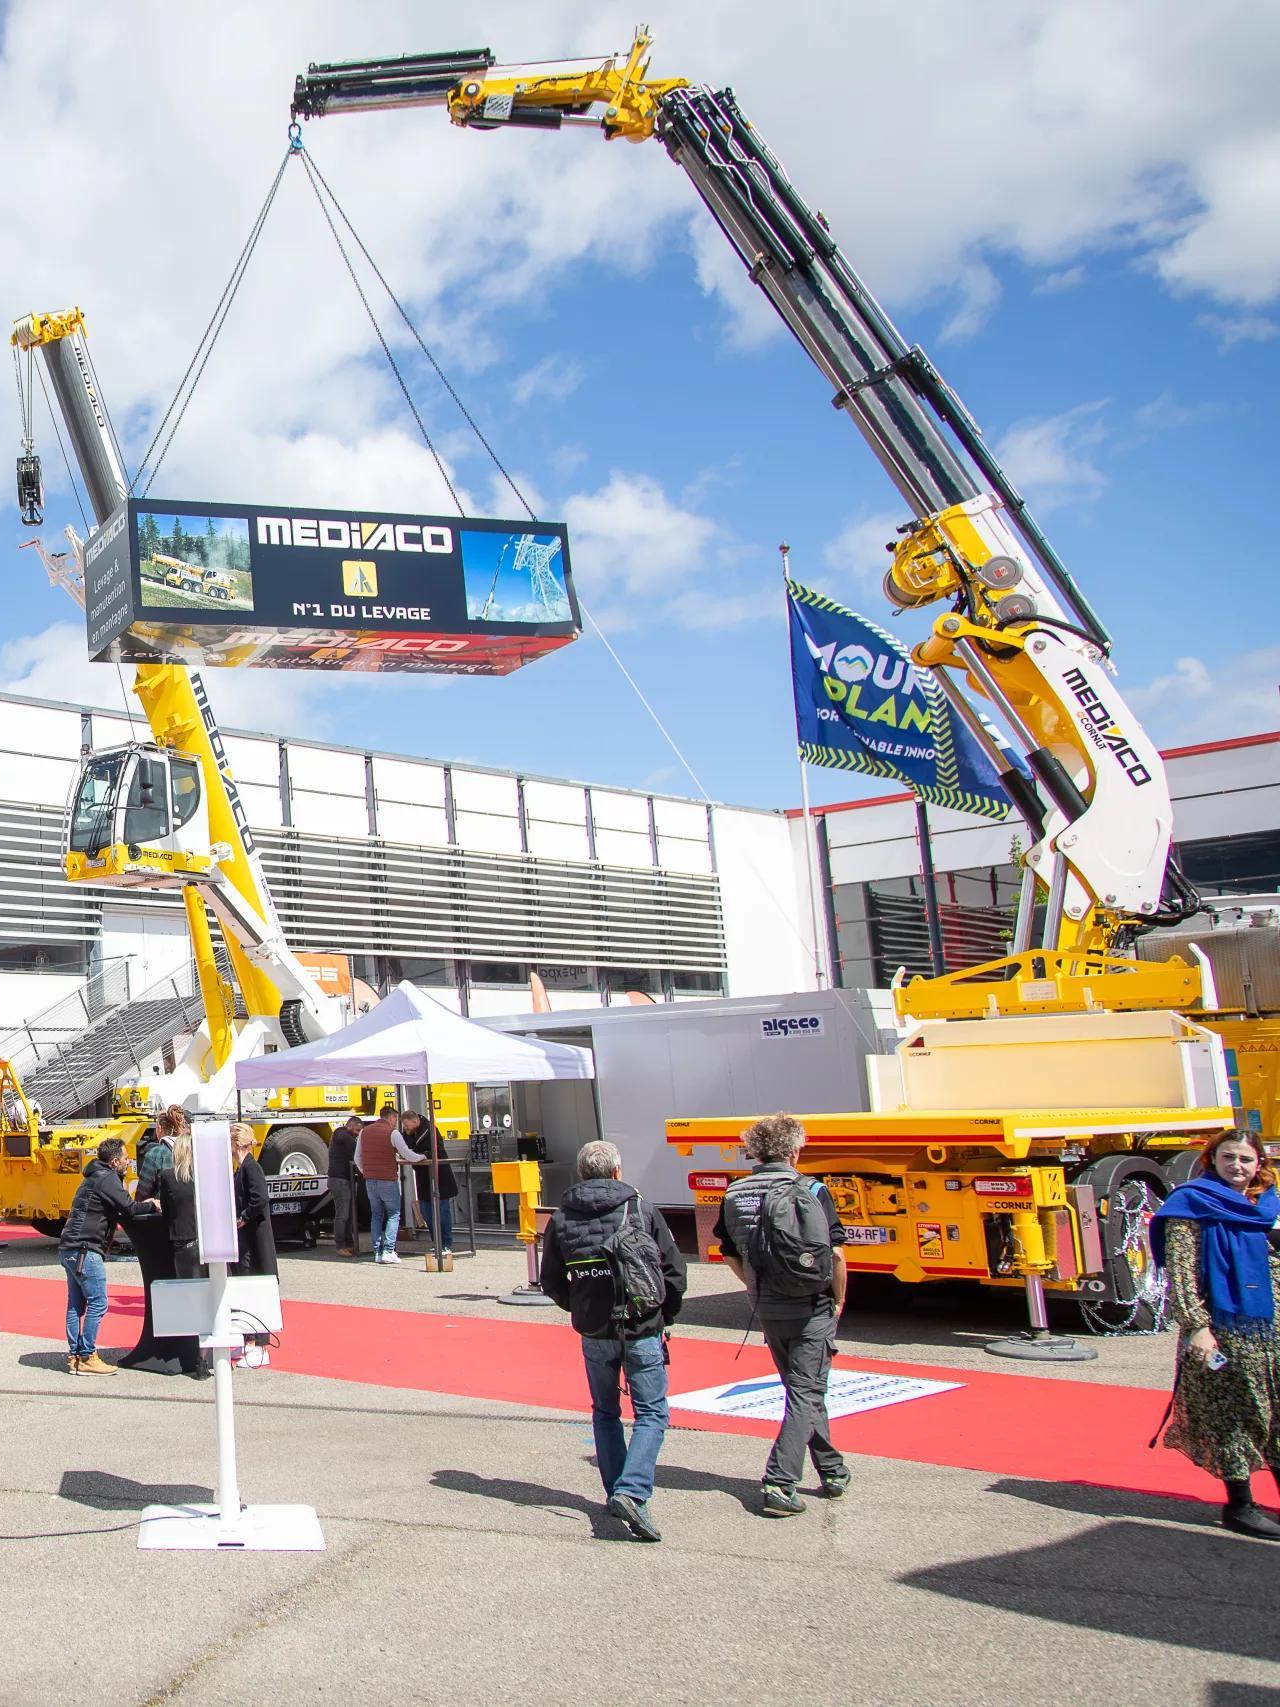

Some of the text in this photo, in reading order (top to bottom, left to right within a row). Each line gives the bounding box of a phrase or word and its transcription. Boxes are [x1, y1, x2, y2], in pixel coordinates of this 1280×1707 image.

[94, 559, 120, 594] Levage &
[90, 580, 126, 621] manutention
[330, 604, 356, 617] DU
[362, 605, 431, 621] LEVAGE
[92, 604, 128, 643] en montagne
[402, 661, 505, 673] montagne
[1080, 717, 1107, 750] CORNUT
[762, 1017, 820, 1036] algeco
[702, 1195, 724, 1203] CORN
[994, 1201, 1033, 1210] CORNUT
